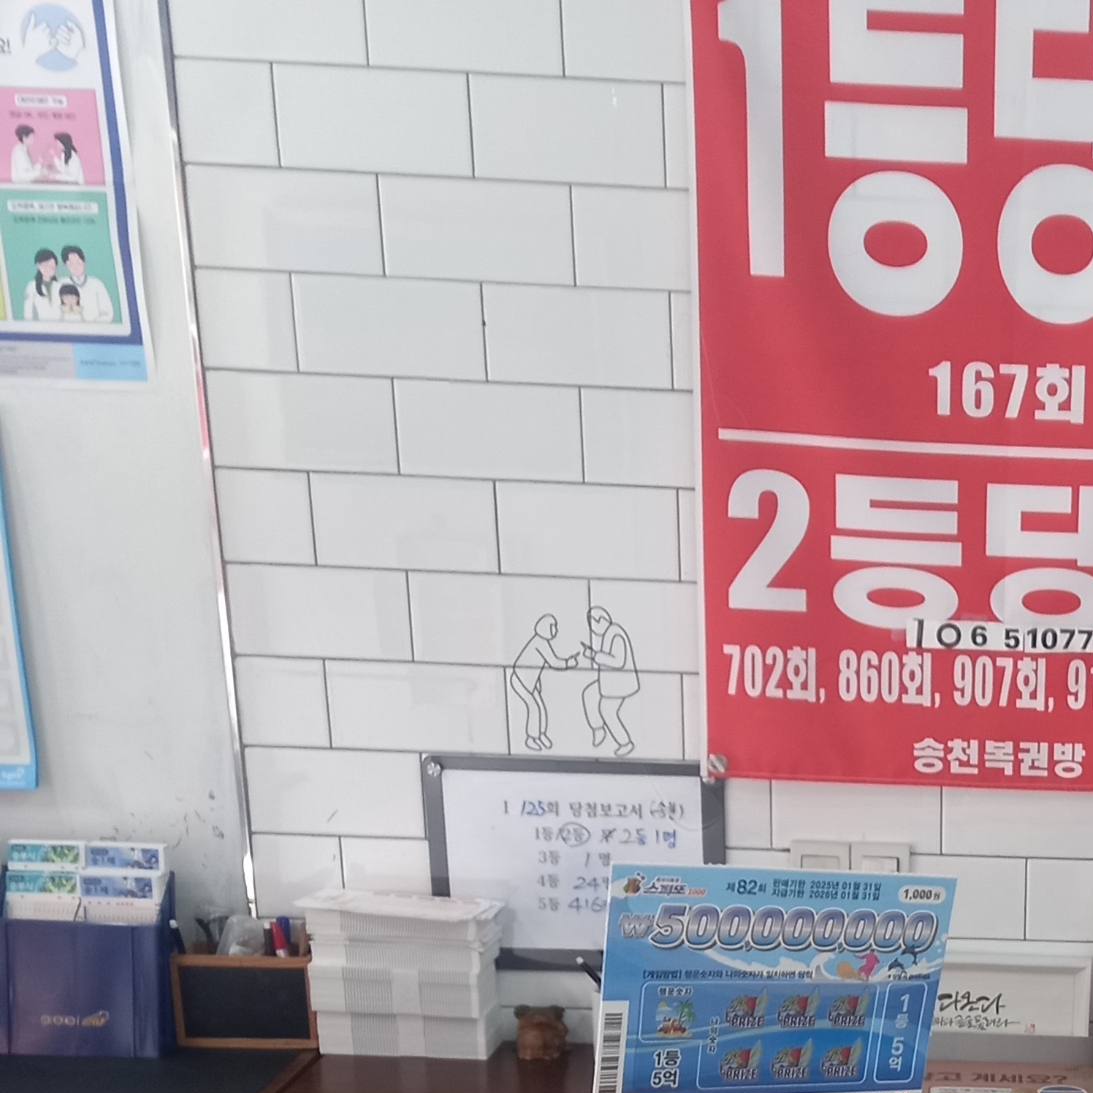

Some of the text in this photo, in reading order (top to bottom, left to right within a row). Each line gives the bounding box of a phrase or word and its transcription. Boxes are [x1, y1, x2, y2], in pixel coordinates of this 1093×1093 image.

[928, 360, 1086, 424] 167회
[1026, 628, 1093, 653] 1077
[723, 643, 826, 704] 702회,
[838, 649, 940, 709] 860회,
[953, 655, 1055, 713] 907회,
[913, 736, 1087, 777] 송천복권방
[809, 889, 839, 900] 2026년
[861, 890, 881, 901] 31일
[810, 880, 840, 891] 2025년
[863, 881, 883, 892] 31일
[654, 1048, 682, 1068] 1등
[650, 1068, 680, 1088] 5억
